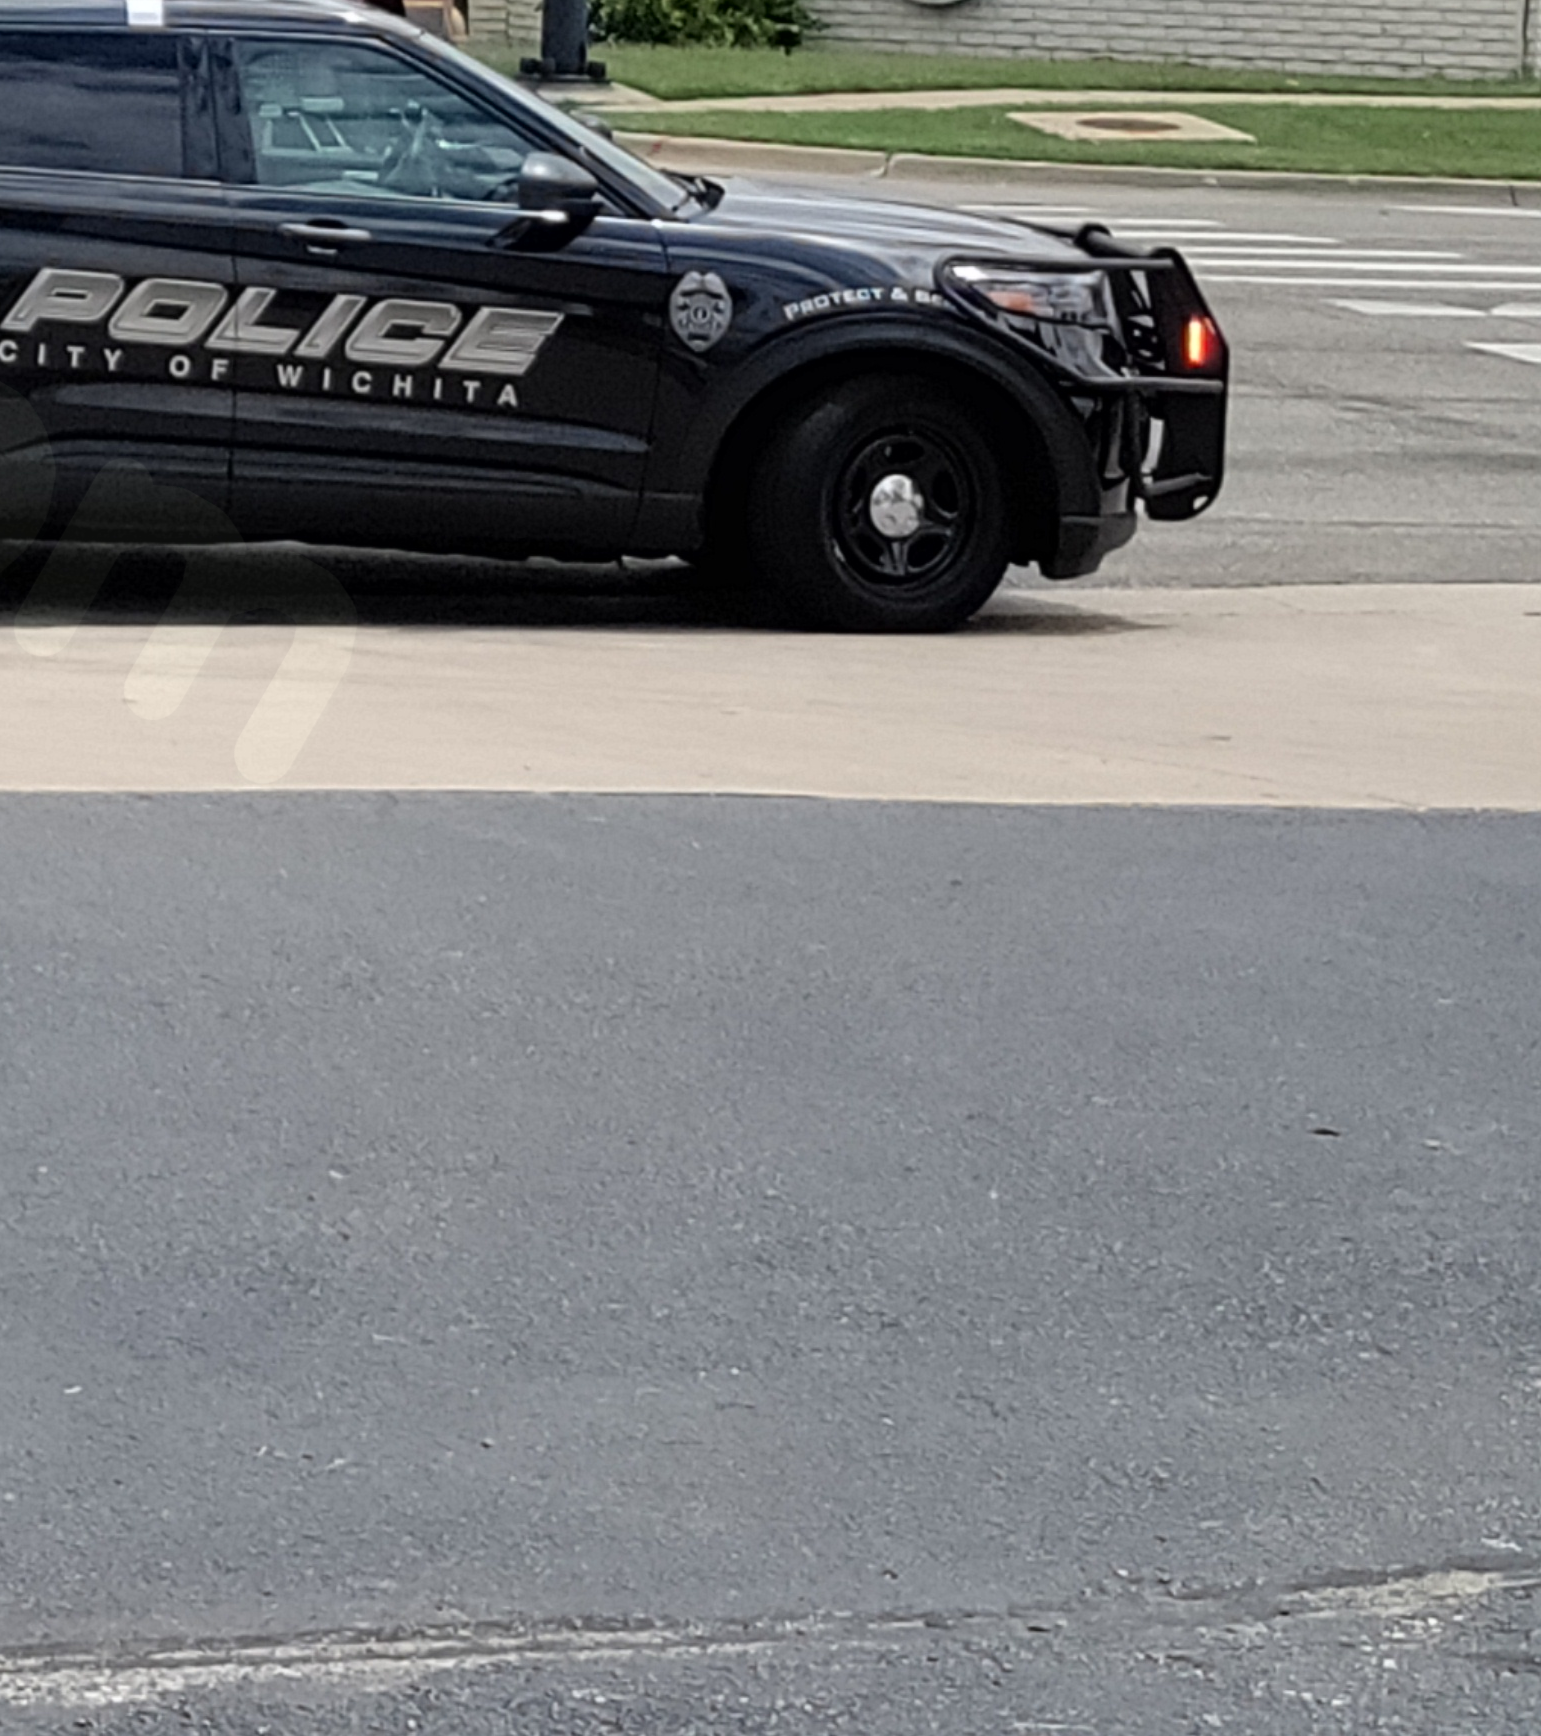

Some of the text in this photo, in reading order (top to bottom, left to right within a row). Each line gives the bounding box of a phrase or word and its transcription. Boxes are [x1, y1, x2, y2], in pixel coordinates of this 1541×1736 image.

[0, 266, 565, 377] POLICE
[782, 286, 885, 322] PROTECT
[169, 354, 230, 382] OF
[277, 363, 519, 406] WICHITA
